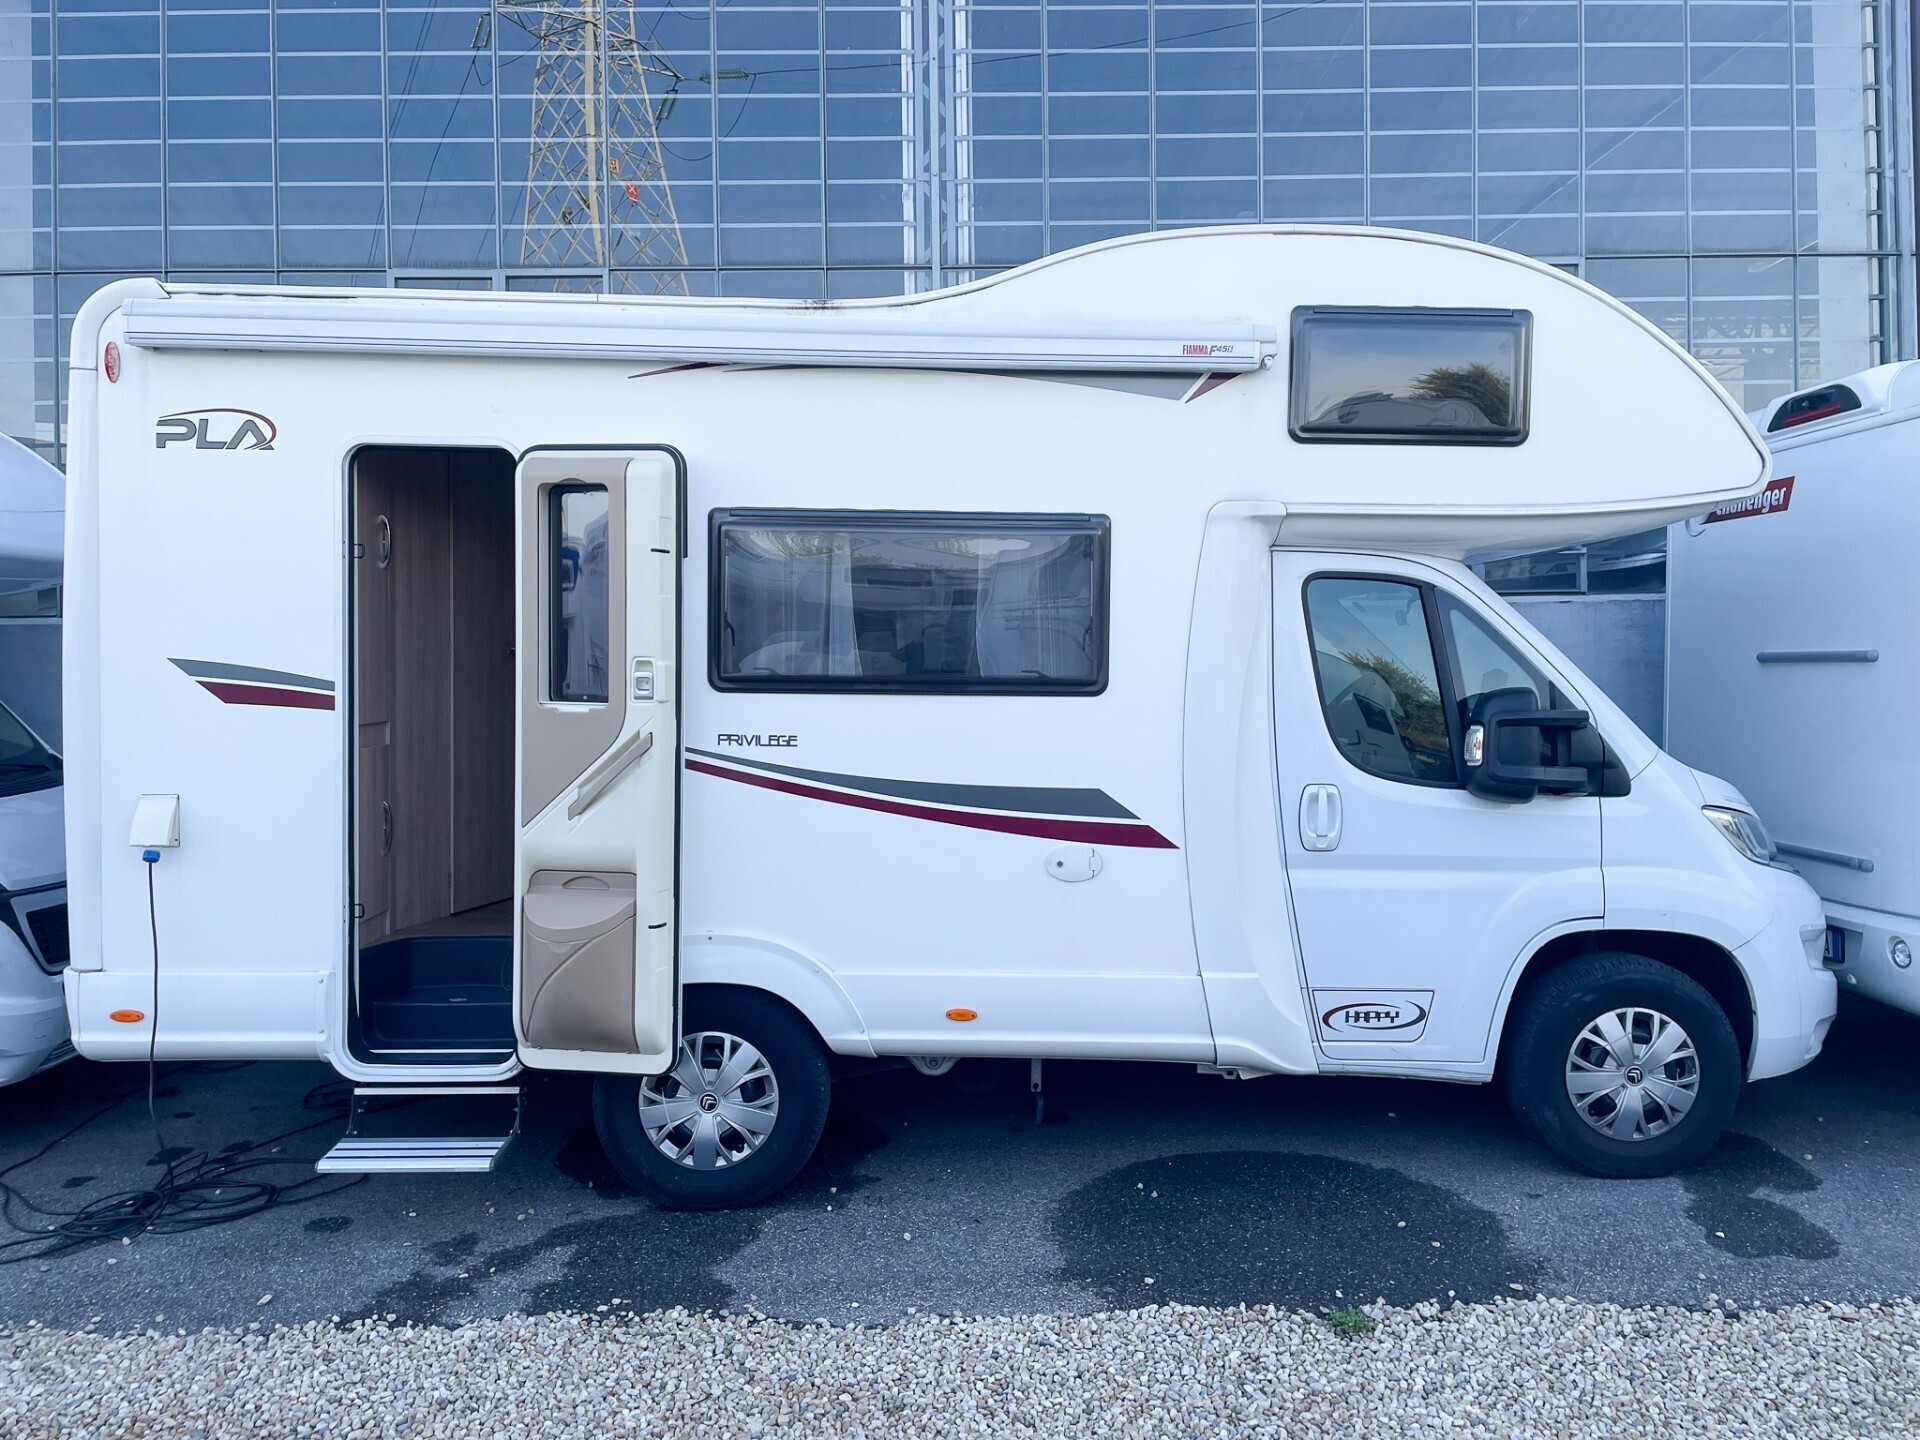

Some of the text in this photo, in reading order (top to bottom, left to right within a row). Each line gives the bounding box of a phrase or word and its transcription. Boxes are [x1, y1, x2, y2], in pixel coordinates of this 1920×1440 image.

[1182, 344, 1209, 355] FIAMMA
[156, 418, 275, 451] PLA
[717, 733, 799, 748] PRIVILEGE
[1345, 1010, 1400, 1024] HAPPY
